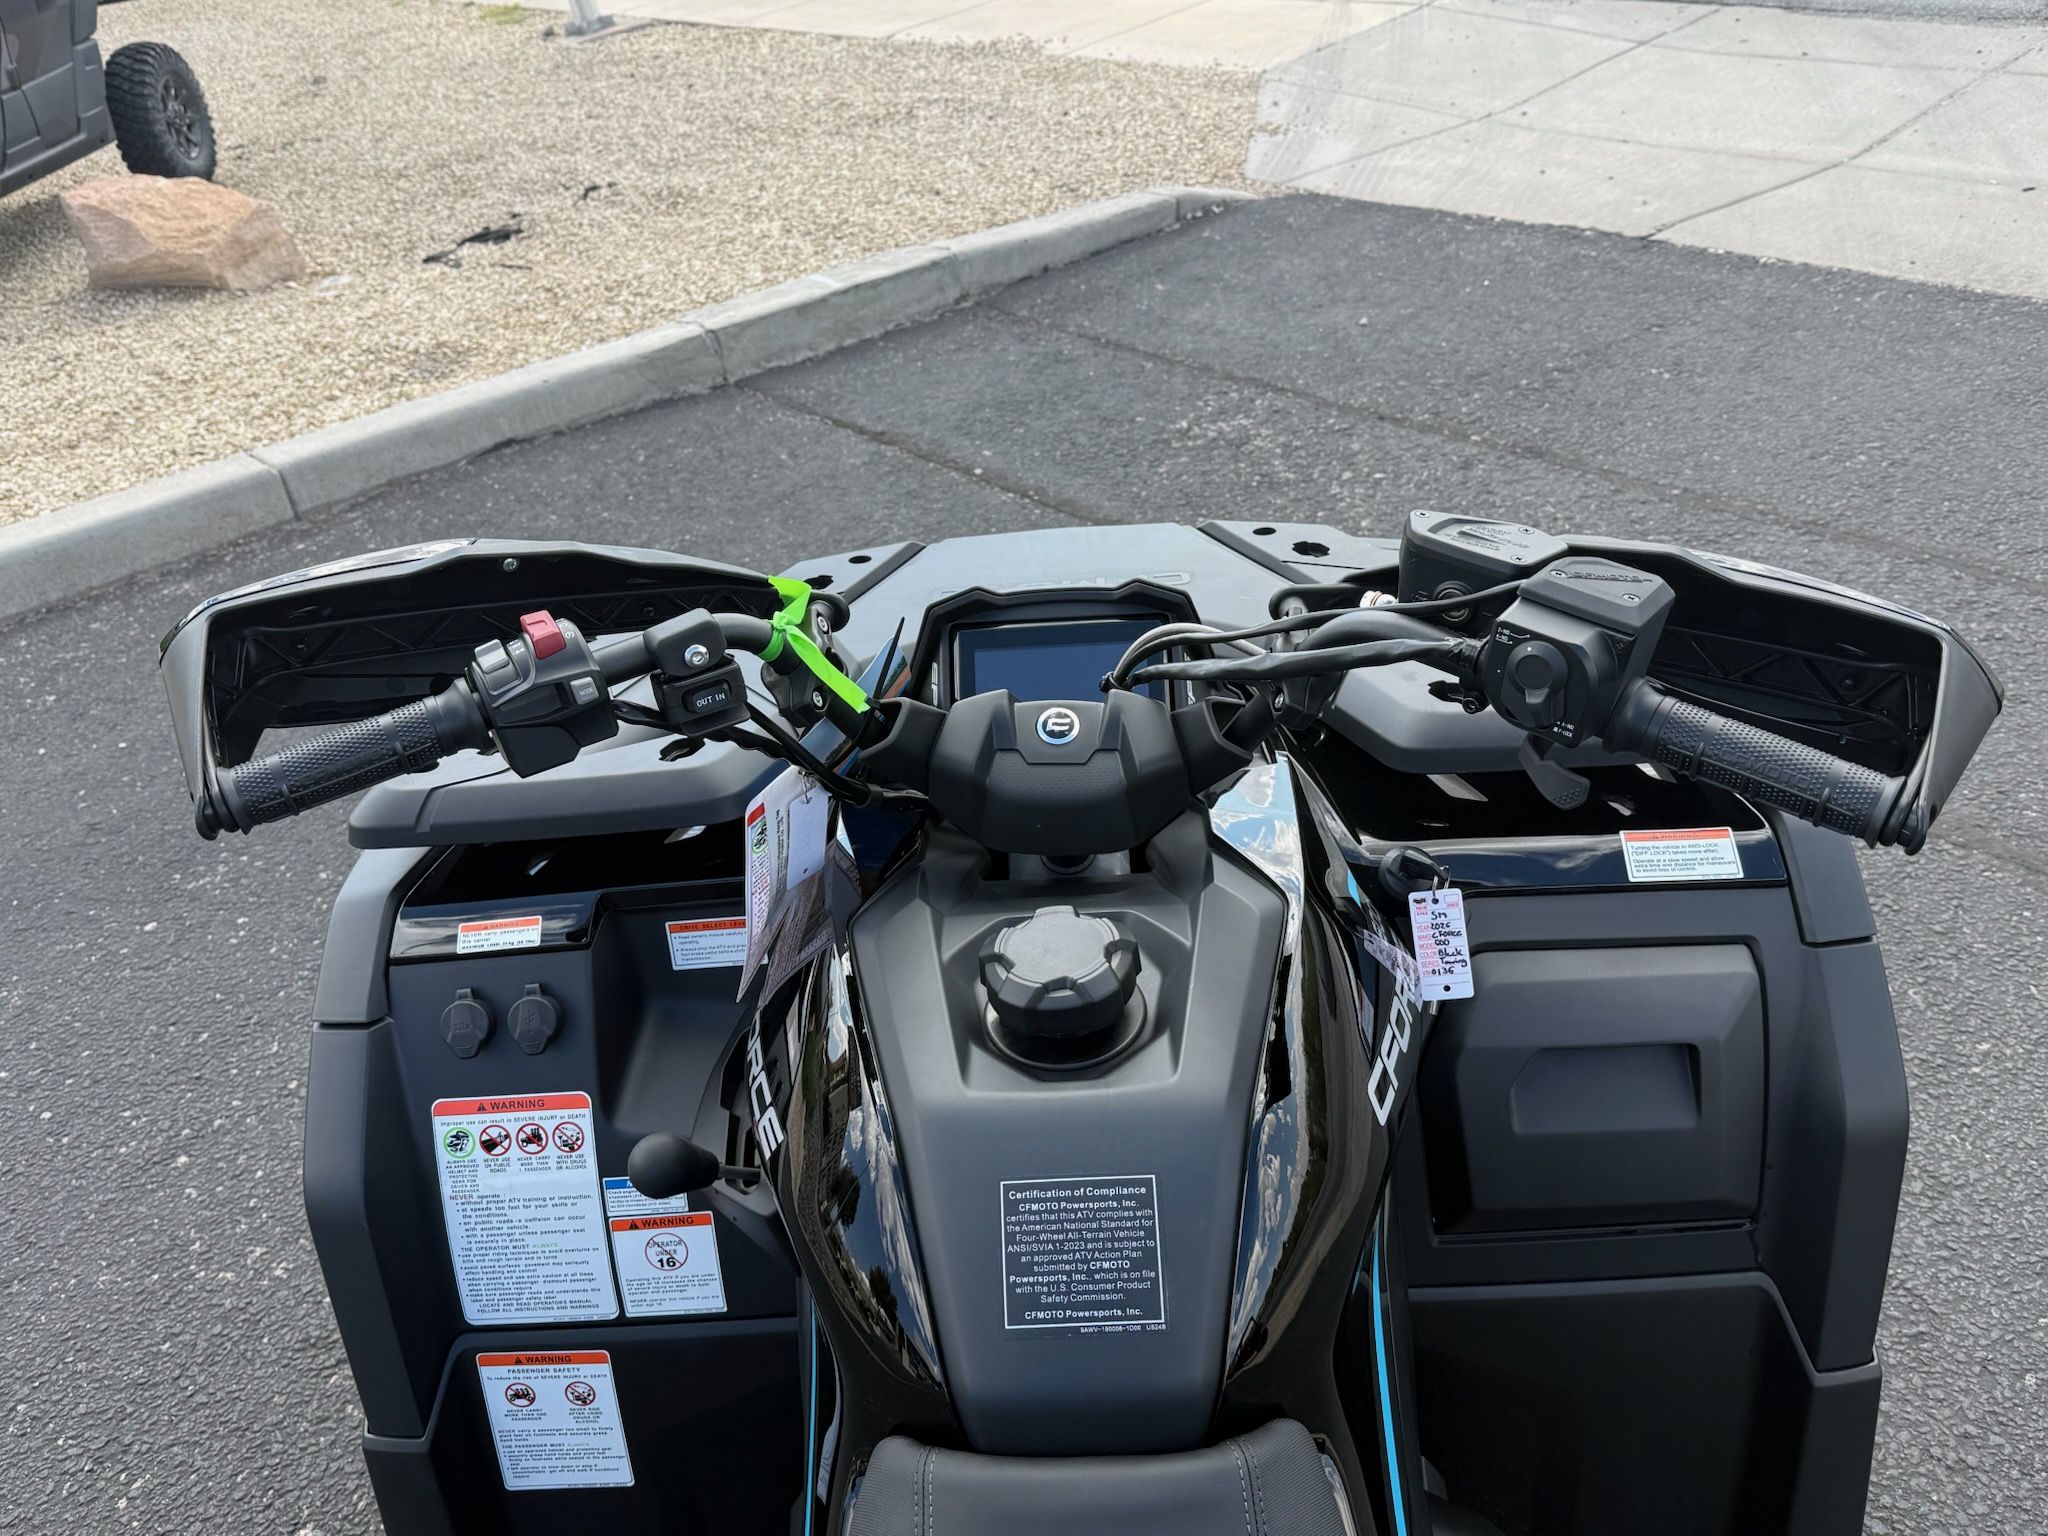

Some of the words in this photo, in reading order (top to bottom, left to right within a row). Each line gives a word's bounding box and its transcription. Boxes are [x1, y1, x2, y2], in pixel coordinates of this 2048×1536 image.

[580, 687, 594, 695] MODE
[696, 696, 712, 707] OUT
[1431, 966, 1455, 975] 0136
[491, 1100, 545, 1110] WARNING
[441, 1120, 464, 1128] Improper
[1009, 1189, 1071, 1199] Certification
[1074, 1188, 1084, 1196] of
[1086, 1186, 1146, 1197] Compliance
[1019, 1203, 1058, 1211] CFMOTO
[1061, 1200, 1120, 1210] Powersports,
[1006, 1214, 1039, 1222] certifies
[1042, 1213, 1058, 1221] that
[1060, 1212, 1075, 1220] this
[1096, 1210, 1133, 1220] complies
[642, 1217, 694, 1227] WARNING
[1022, 1223, 1061, 1231] American
[1064, 1221, 1099, 1230] National
[1101, 1220, 1139, 1228] Standard
[1142, 1219, 1153, 1227] for
[1017, 1233, 1065, 1242] Four-Wheel
[1068, 1231, 1111, 1240] All-Terrain
[1114, 1230, 1144, 1238] Vehicle
[648, 1240, 682, 1248] OPERATOR
[1008, 1244, 1053, 1252] ANSI/SVIA
[1056, 1242, 1084, 1250] 1-2023
[1087, 1241, 1102, 1249] and
[1114, 1240, 1144, 1249] subject
[1034, 1253, 1073, 1263] approved
[1075, 1252, 1092, 1260] ATV
[1094, 1251, 1120, 1259] Action
[1123, 1250, 1142, 1258] Plan
[658, 1258, 676, 1268] 16
[1034, 1263, 1075, 1272] submitted
[1078, 1262, 1087, 1271] by
[1090, 1261, 1130, 1270] CFMOTO
[1010, 1275, 1070, 1285] Powersports,
[1094, 1272, 1118, 1280] which
[1142, 1270, 1155, 1278] file
[1050, 1284, 1068, 1292] U.S.
[1071, 1282, 1115, 1291] Consumer
[1117, 1281, 1151, 1289] Product
[1041, 1295, 1068, 1304] Safety
[1070, 1293, 1126, 1301] Commission.
[1025, 1311, 1063, 1319] CFMOTO
[1066, 1309, 1124, 1318] Powersports,
